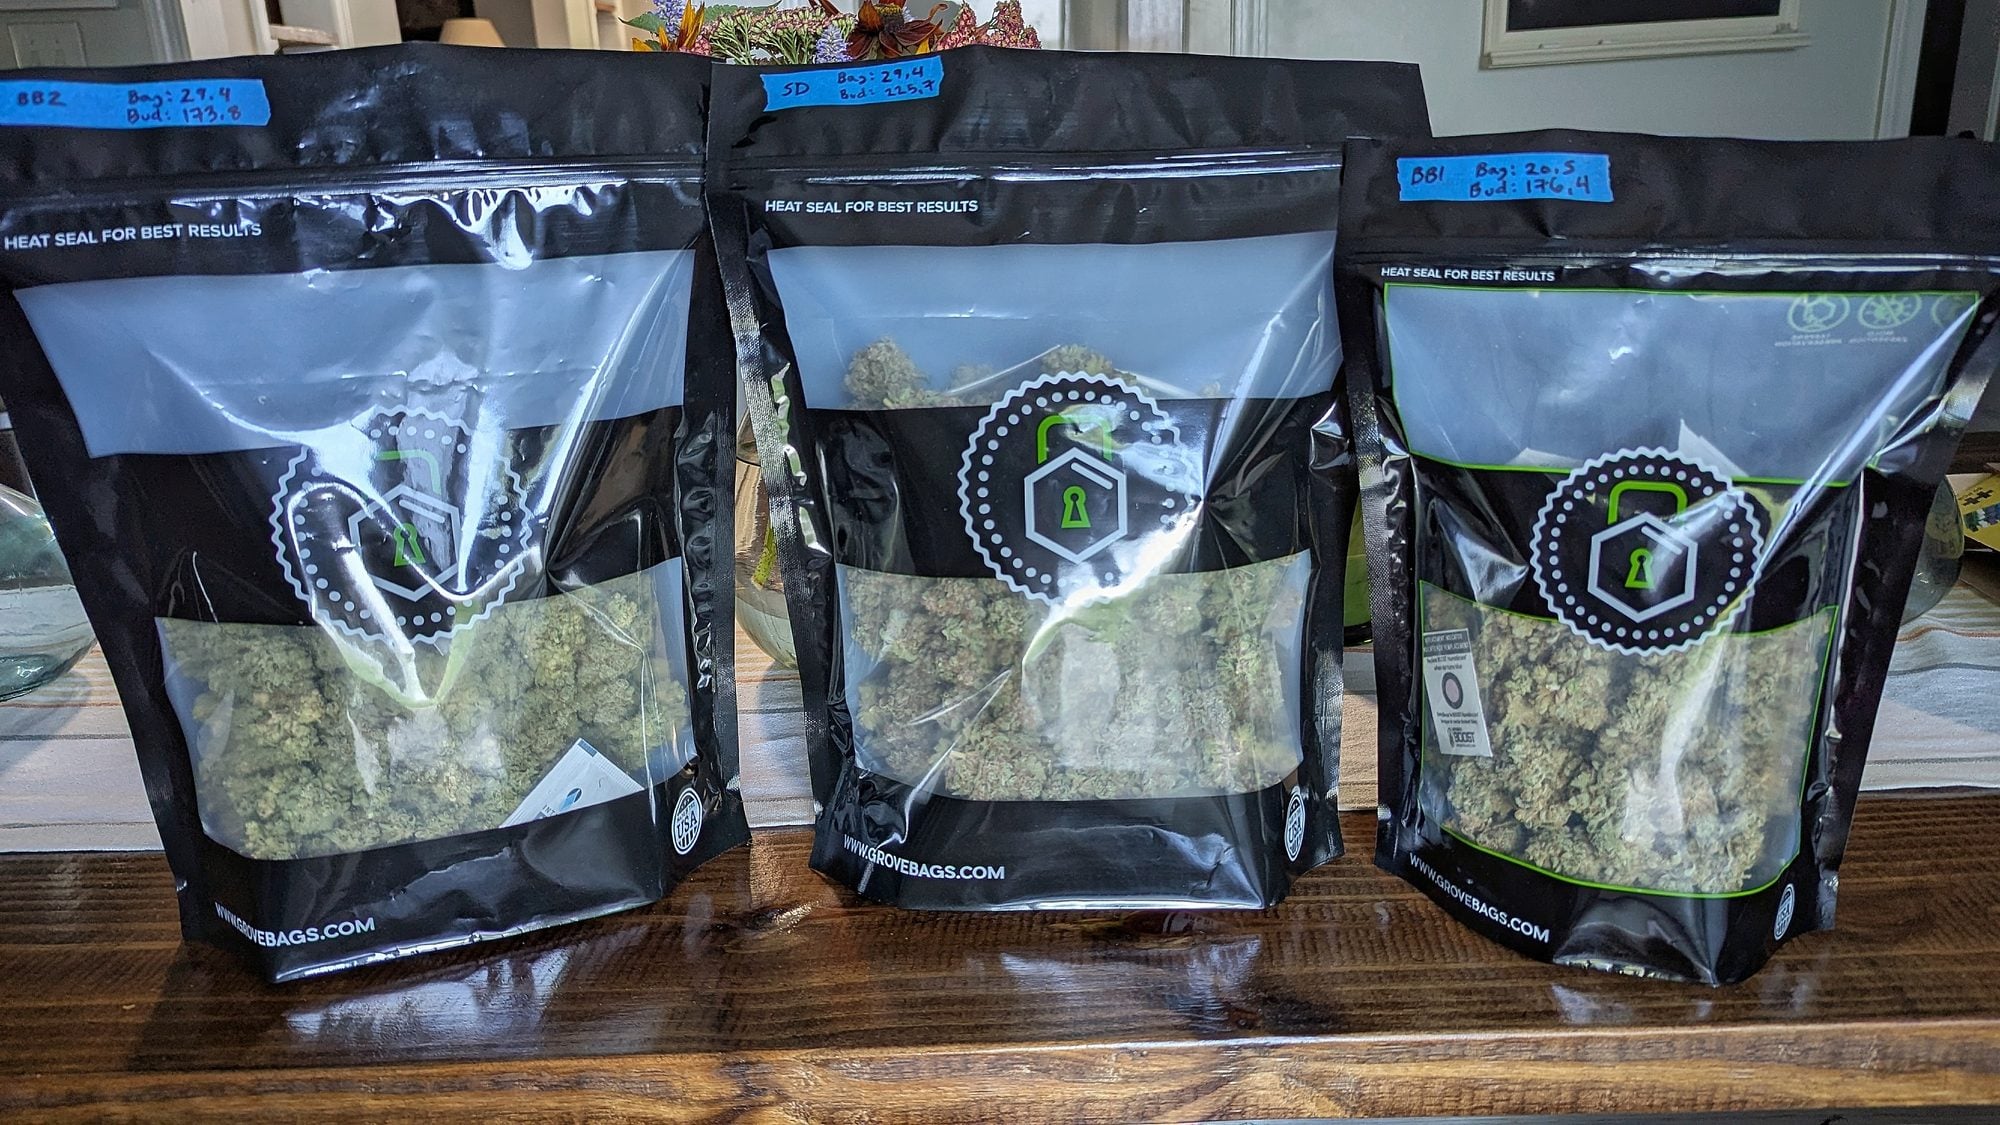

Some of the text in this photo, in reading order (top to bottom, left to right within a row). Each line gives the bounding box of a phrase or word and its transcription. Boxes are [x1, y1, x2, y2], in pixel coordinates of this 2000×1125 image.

[127, 89, 172, 108] Bag:
[781, 82, 810, 97] SD
[840, 87, 875, 100] Bud:
[127, 107, 170, 124] Bud:
[764, 200, 979, 214] HEAT SEAL FOR BEST RESULTS
[4, 223, 262, 250] HEAT SEAL FOR BEST RESULTS
[1381, 266, 1556, 282] HEAT SEAL FOR BEST RESULTS
[677, 810, 698, 839] USA
[843, 833, 1005, 880] WWW.GROVEBAGS.COM
[1409, 852, 1551, 944] WWW.GROVEBAGS.COM
[214, 901, 376, 948] WWW.GROVEBAGS.COM
